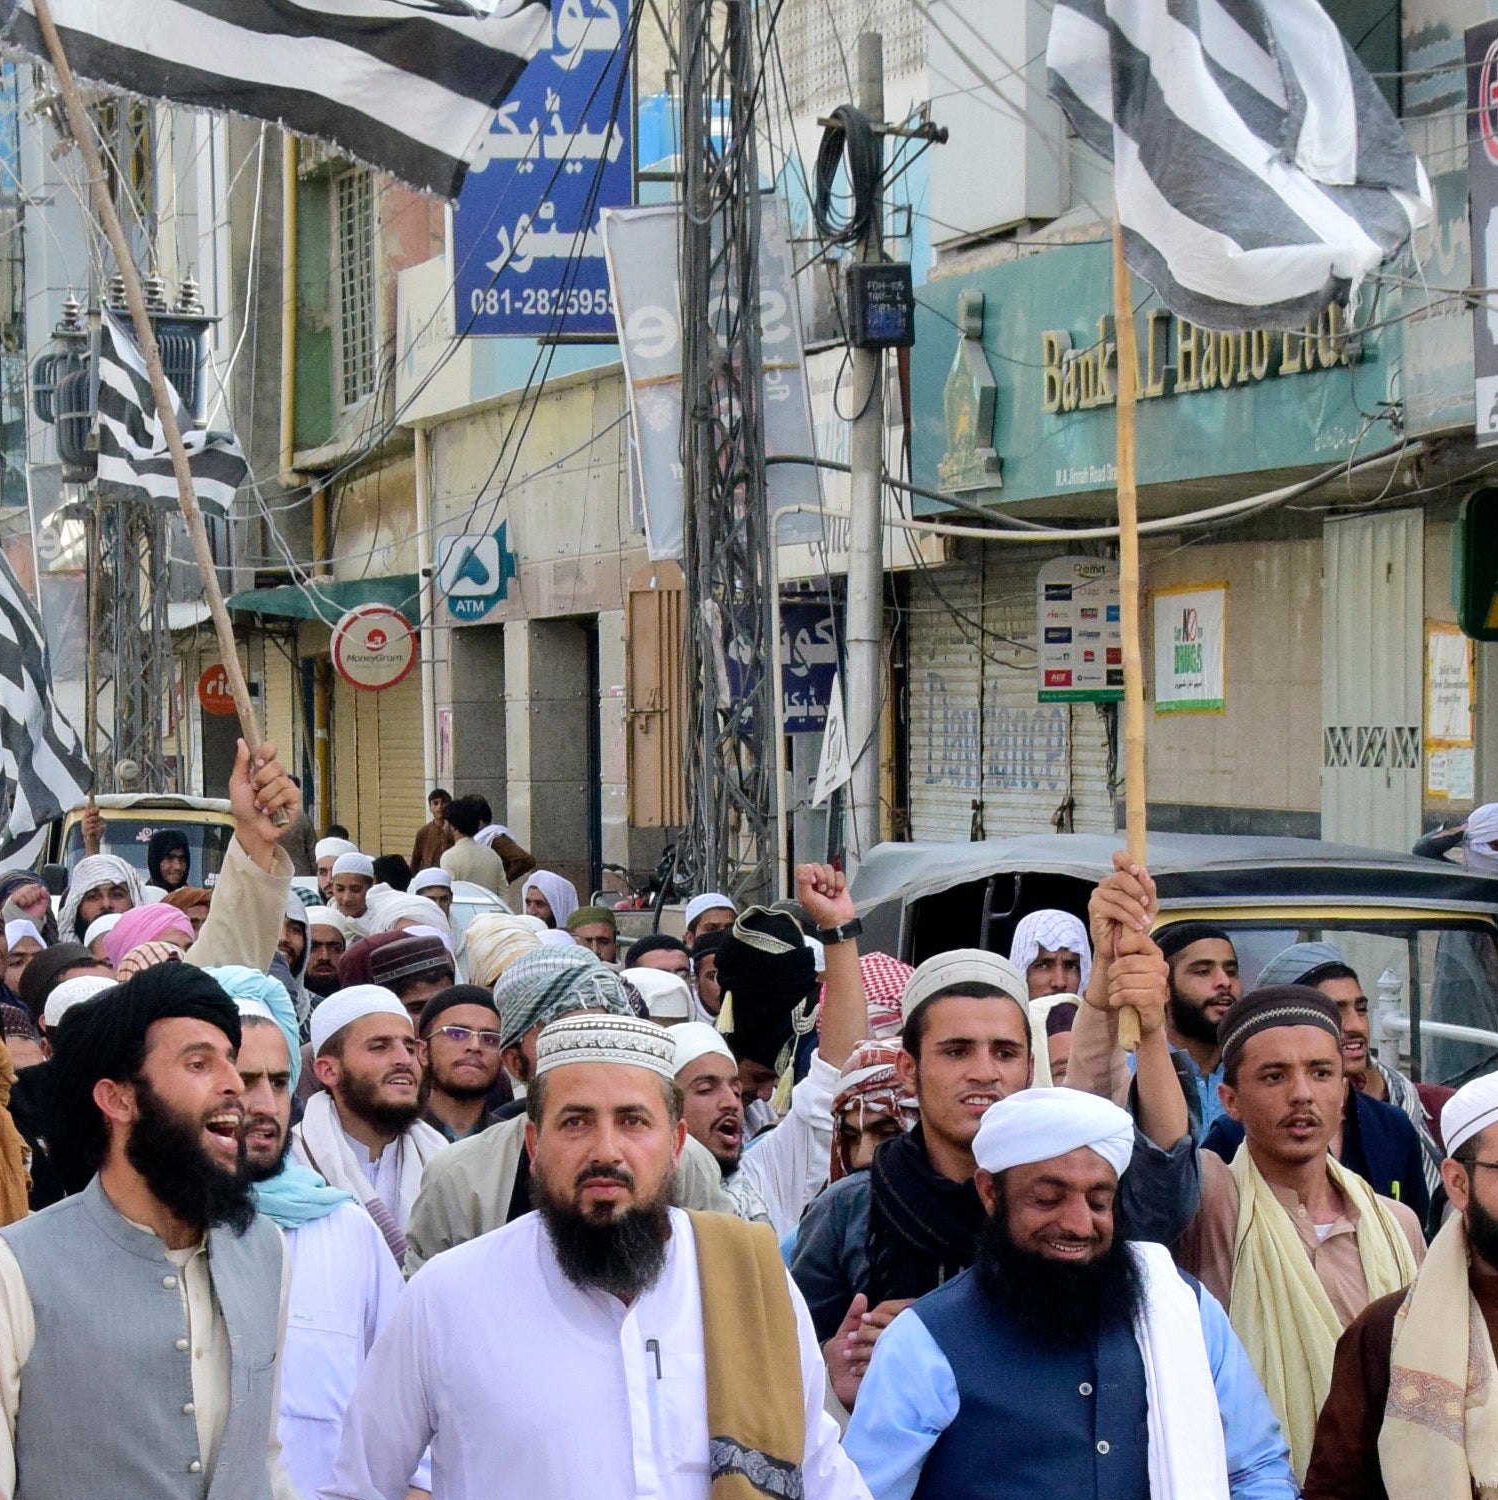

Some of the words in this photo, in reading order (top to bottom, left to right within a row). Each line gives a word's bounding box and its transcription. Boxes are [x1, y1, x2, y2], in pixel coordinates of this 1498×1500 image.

[1042, 314, 1114, 412] Bank
[456, 600, 485, 612] ATM
[347, 653, 403, 664] MoneyGram
